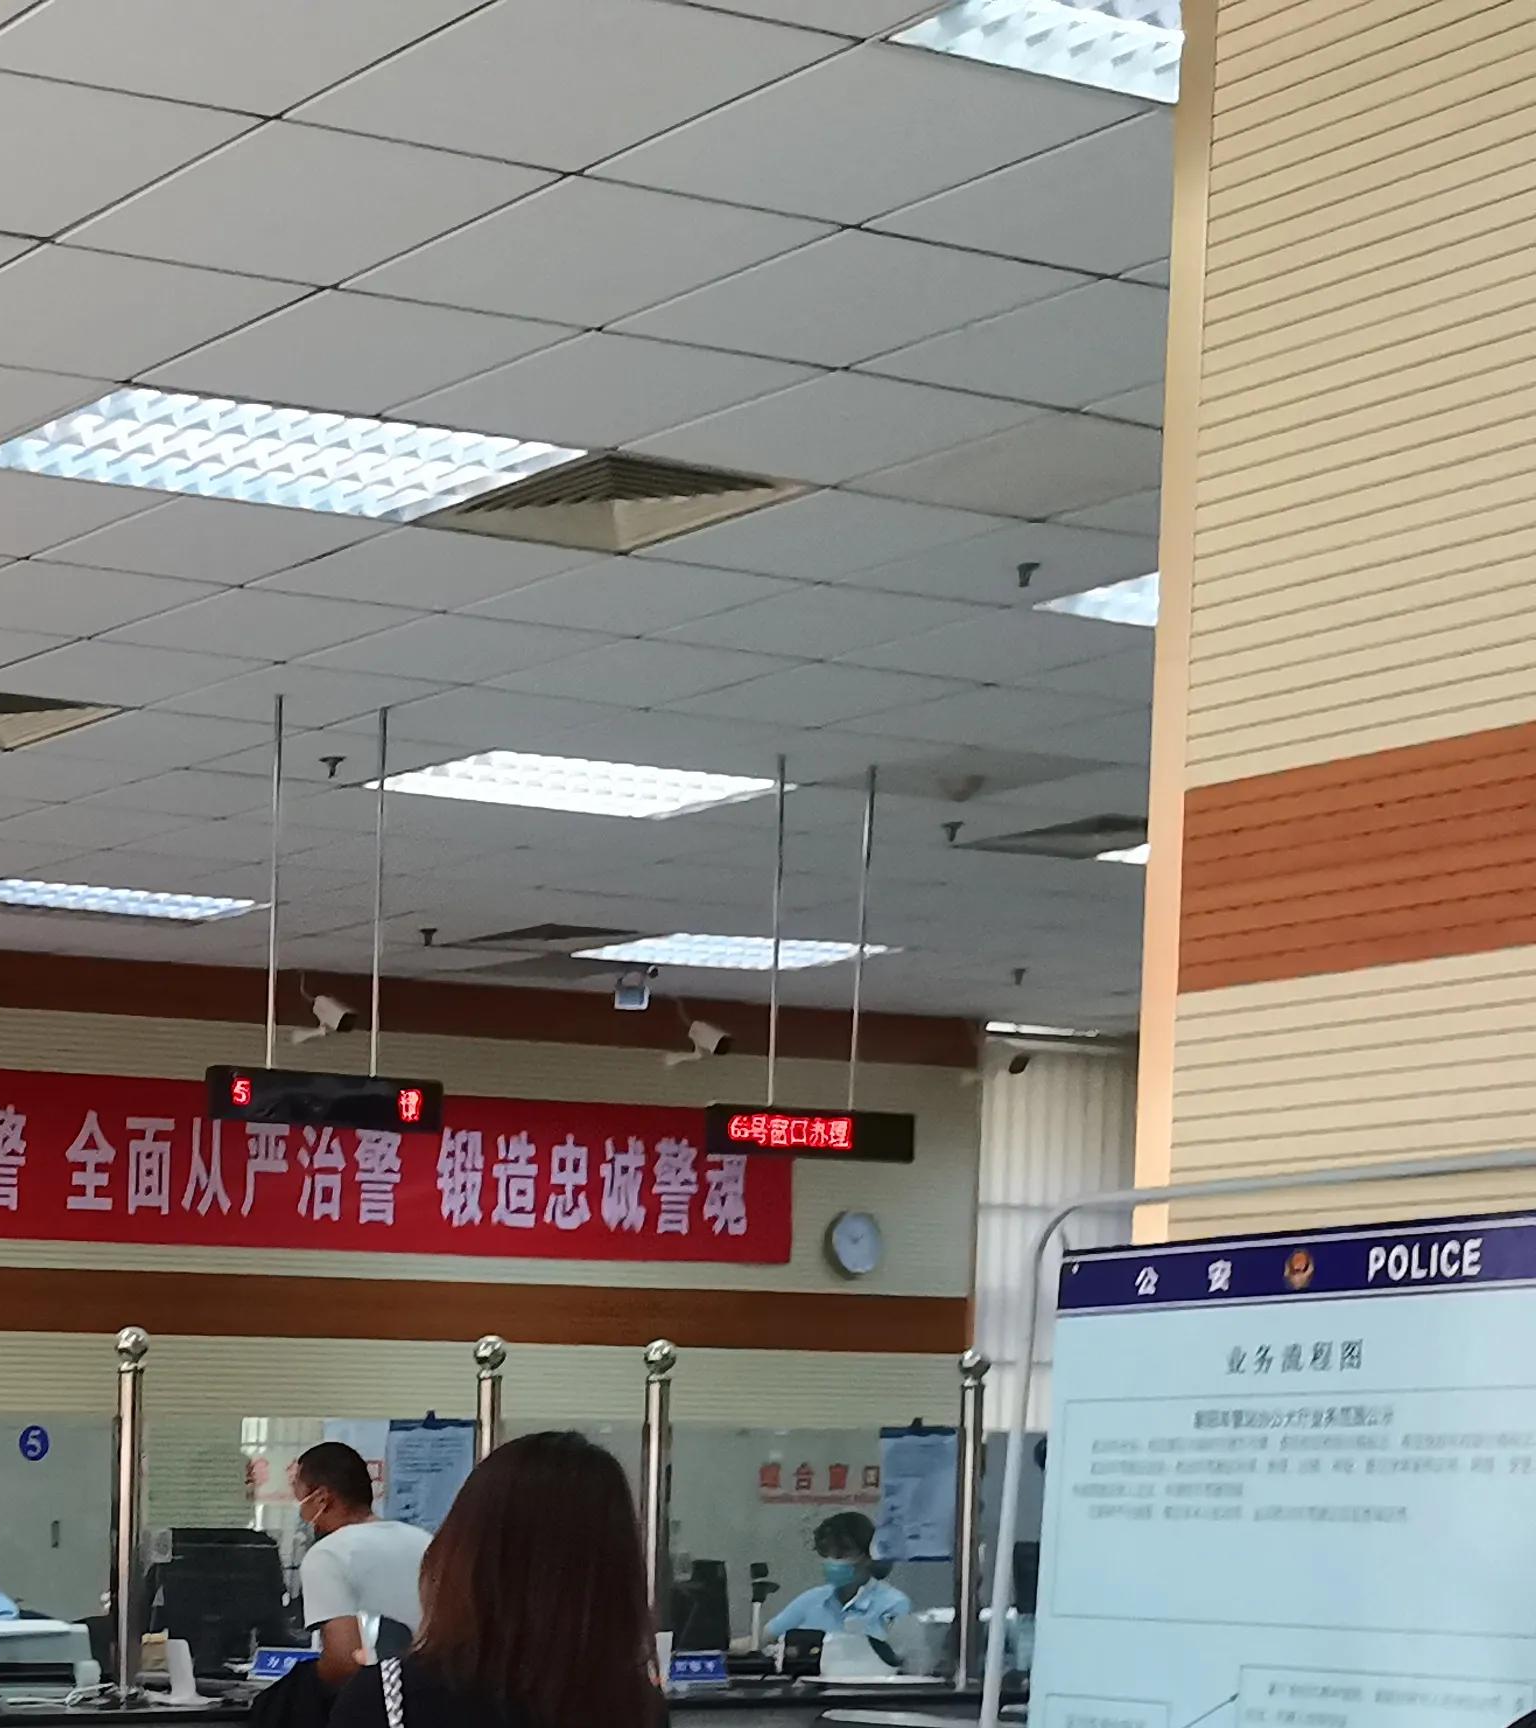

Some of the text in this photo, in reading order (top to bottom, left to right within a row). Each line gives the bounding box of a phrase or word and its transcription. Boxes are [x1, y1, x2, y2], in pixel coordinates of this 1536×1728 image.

[233, 1080, 250, 1104] 5
[65, 1108, 403, 1225] 全面从严治警
[436, 1126, 748, 1236] 锻造忠诚警魂
[1367, 1238, 1483, 1284] POLICE
[1227, 1339, 1364, 1375] 业务流程图
